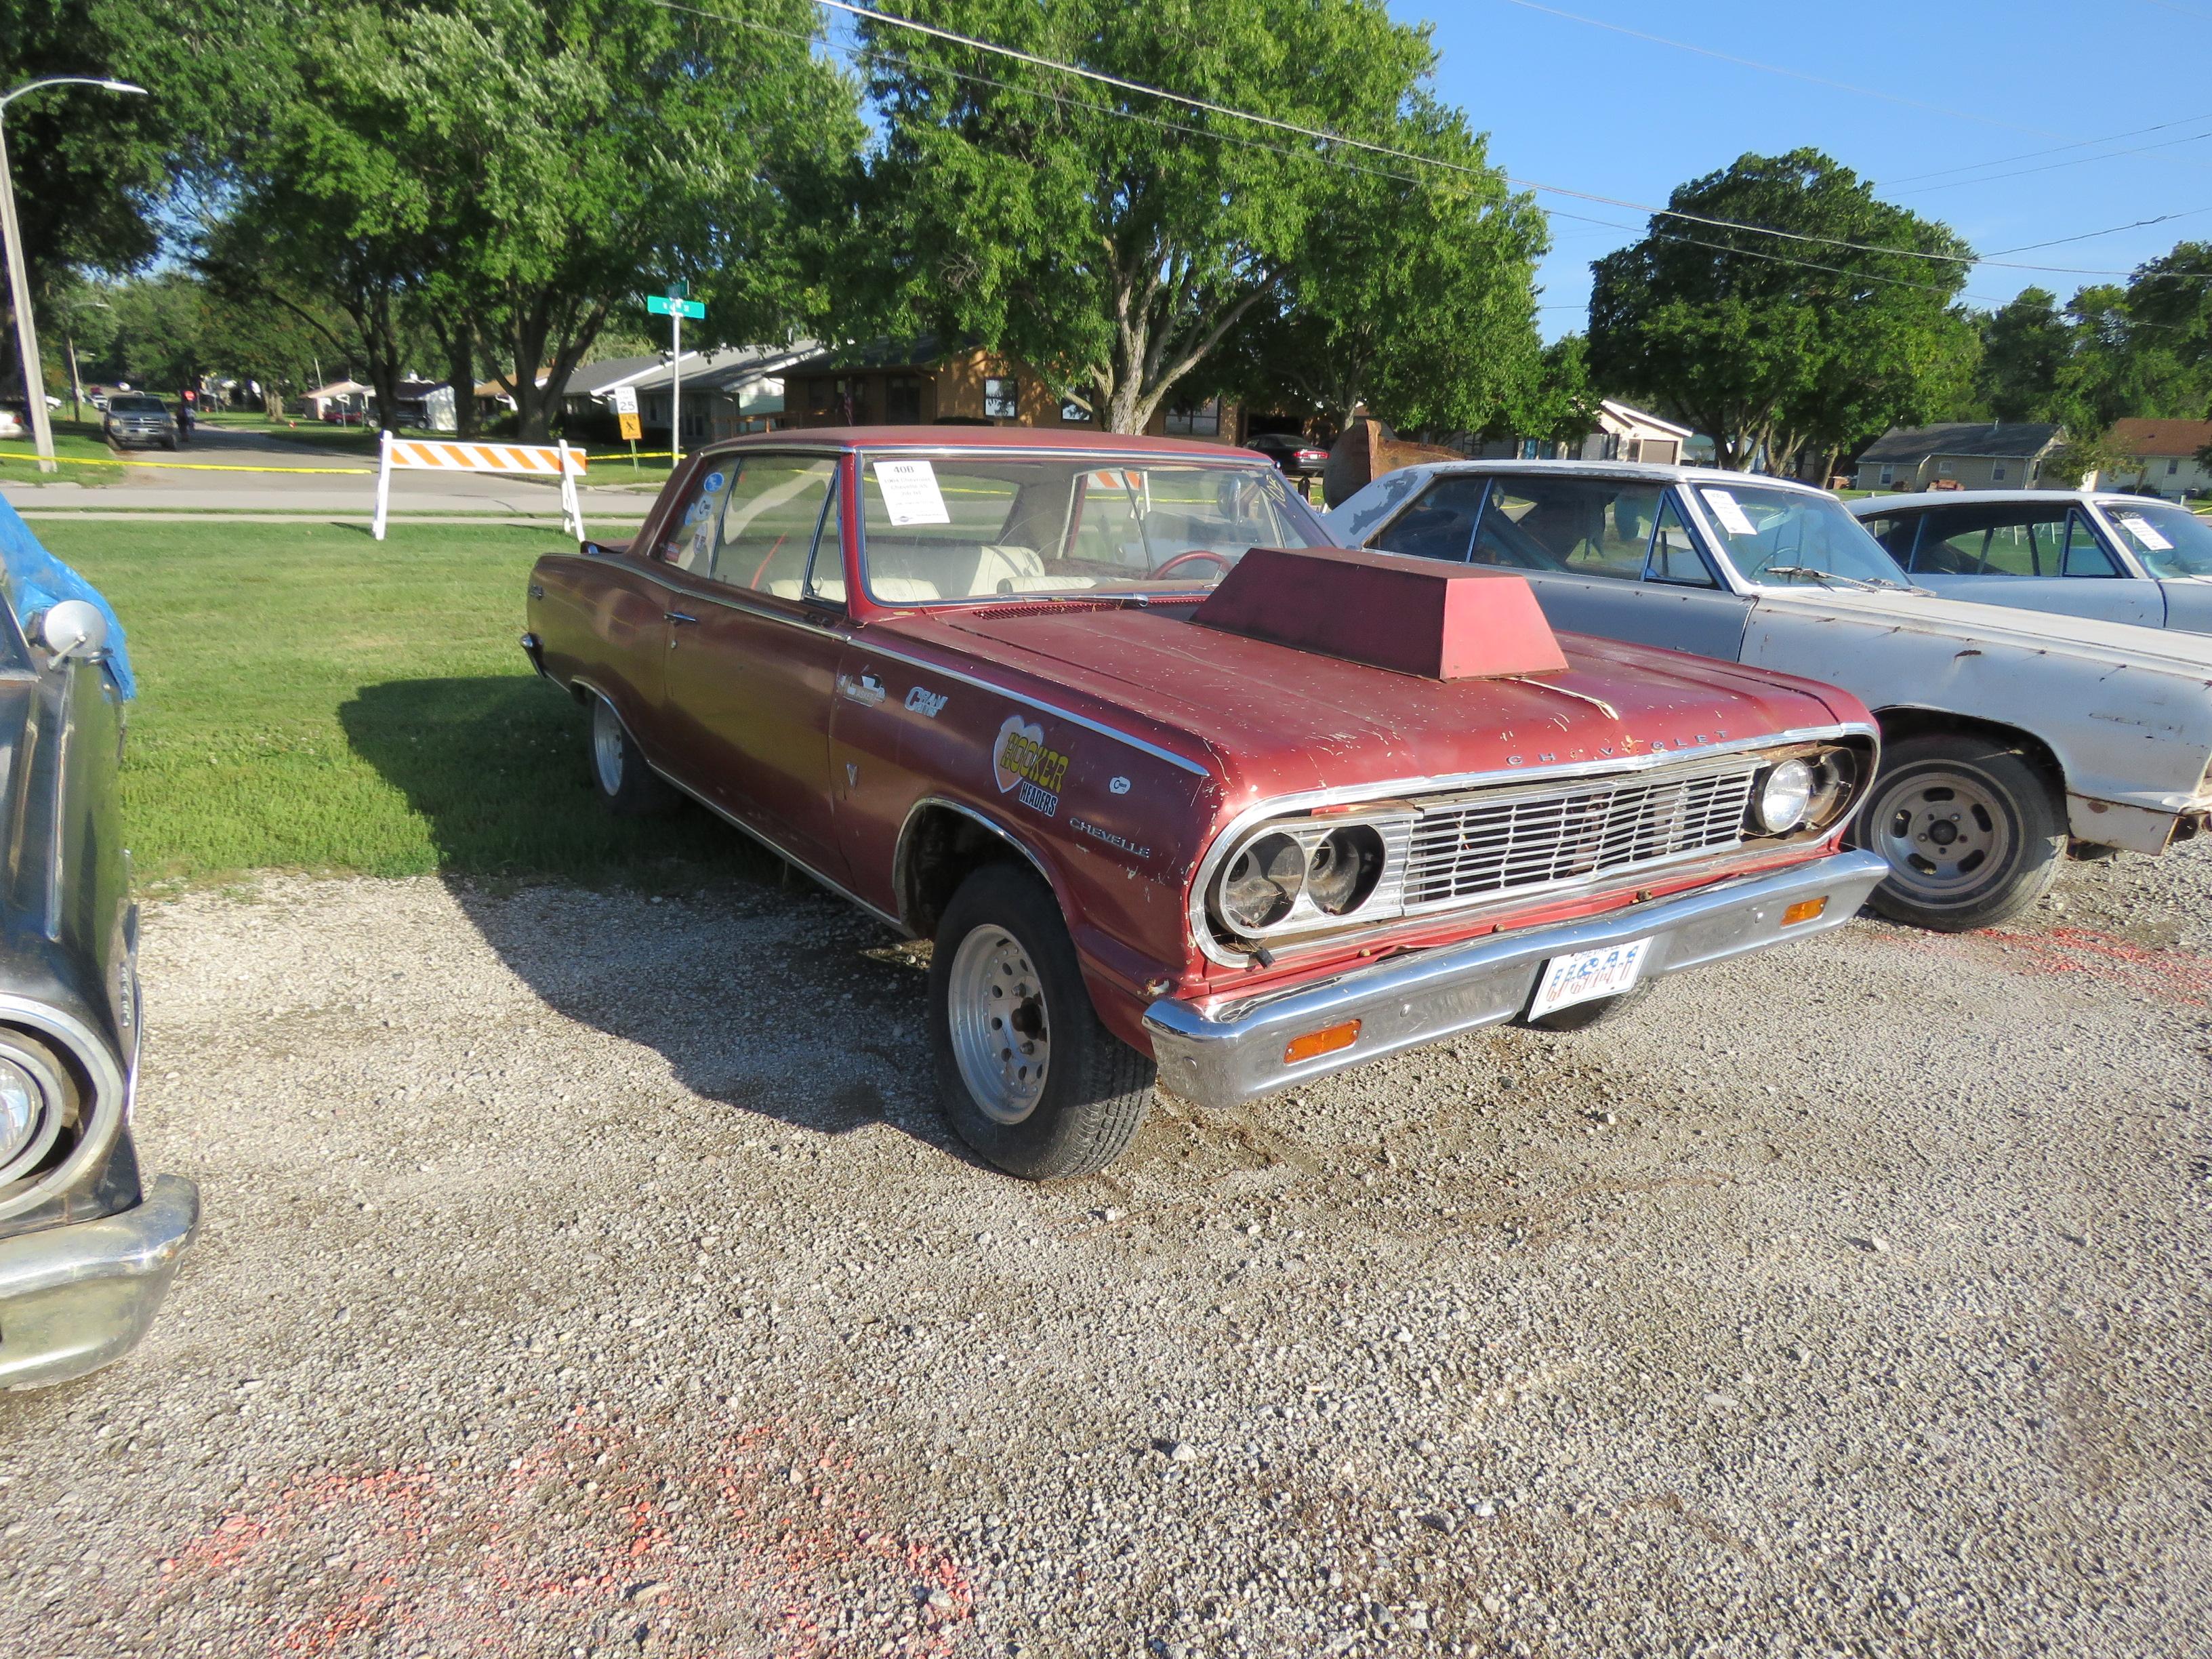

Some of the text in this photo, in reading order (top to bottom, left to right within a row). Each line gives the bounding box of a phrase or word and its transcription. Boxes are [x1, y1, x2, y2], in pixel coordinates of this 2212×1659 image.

[619, 401, 635, 411] 25
[1000, 732, 1069, 794] HOOKER
[1507, 730, 1727, 765] CHVOLET
[1019, 782, 1057, 816] HEADERS
[1069, 817, 1150, 858] CHEVELLE
[1546, 945, 1639, 1002] USA-1
